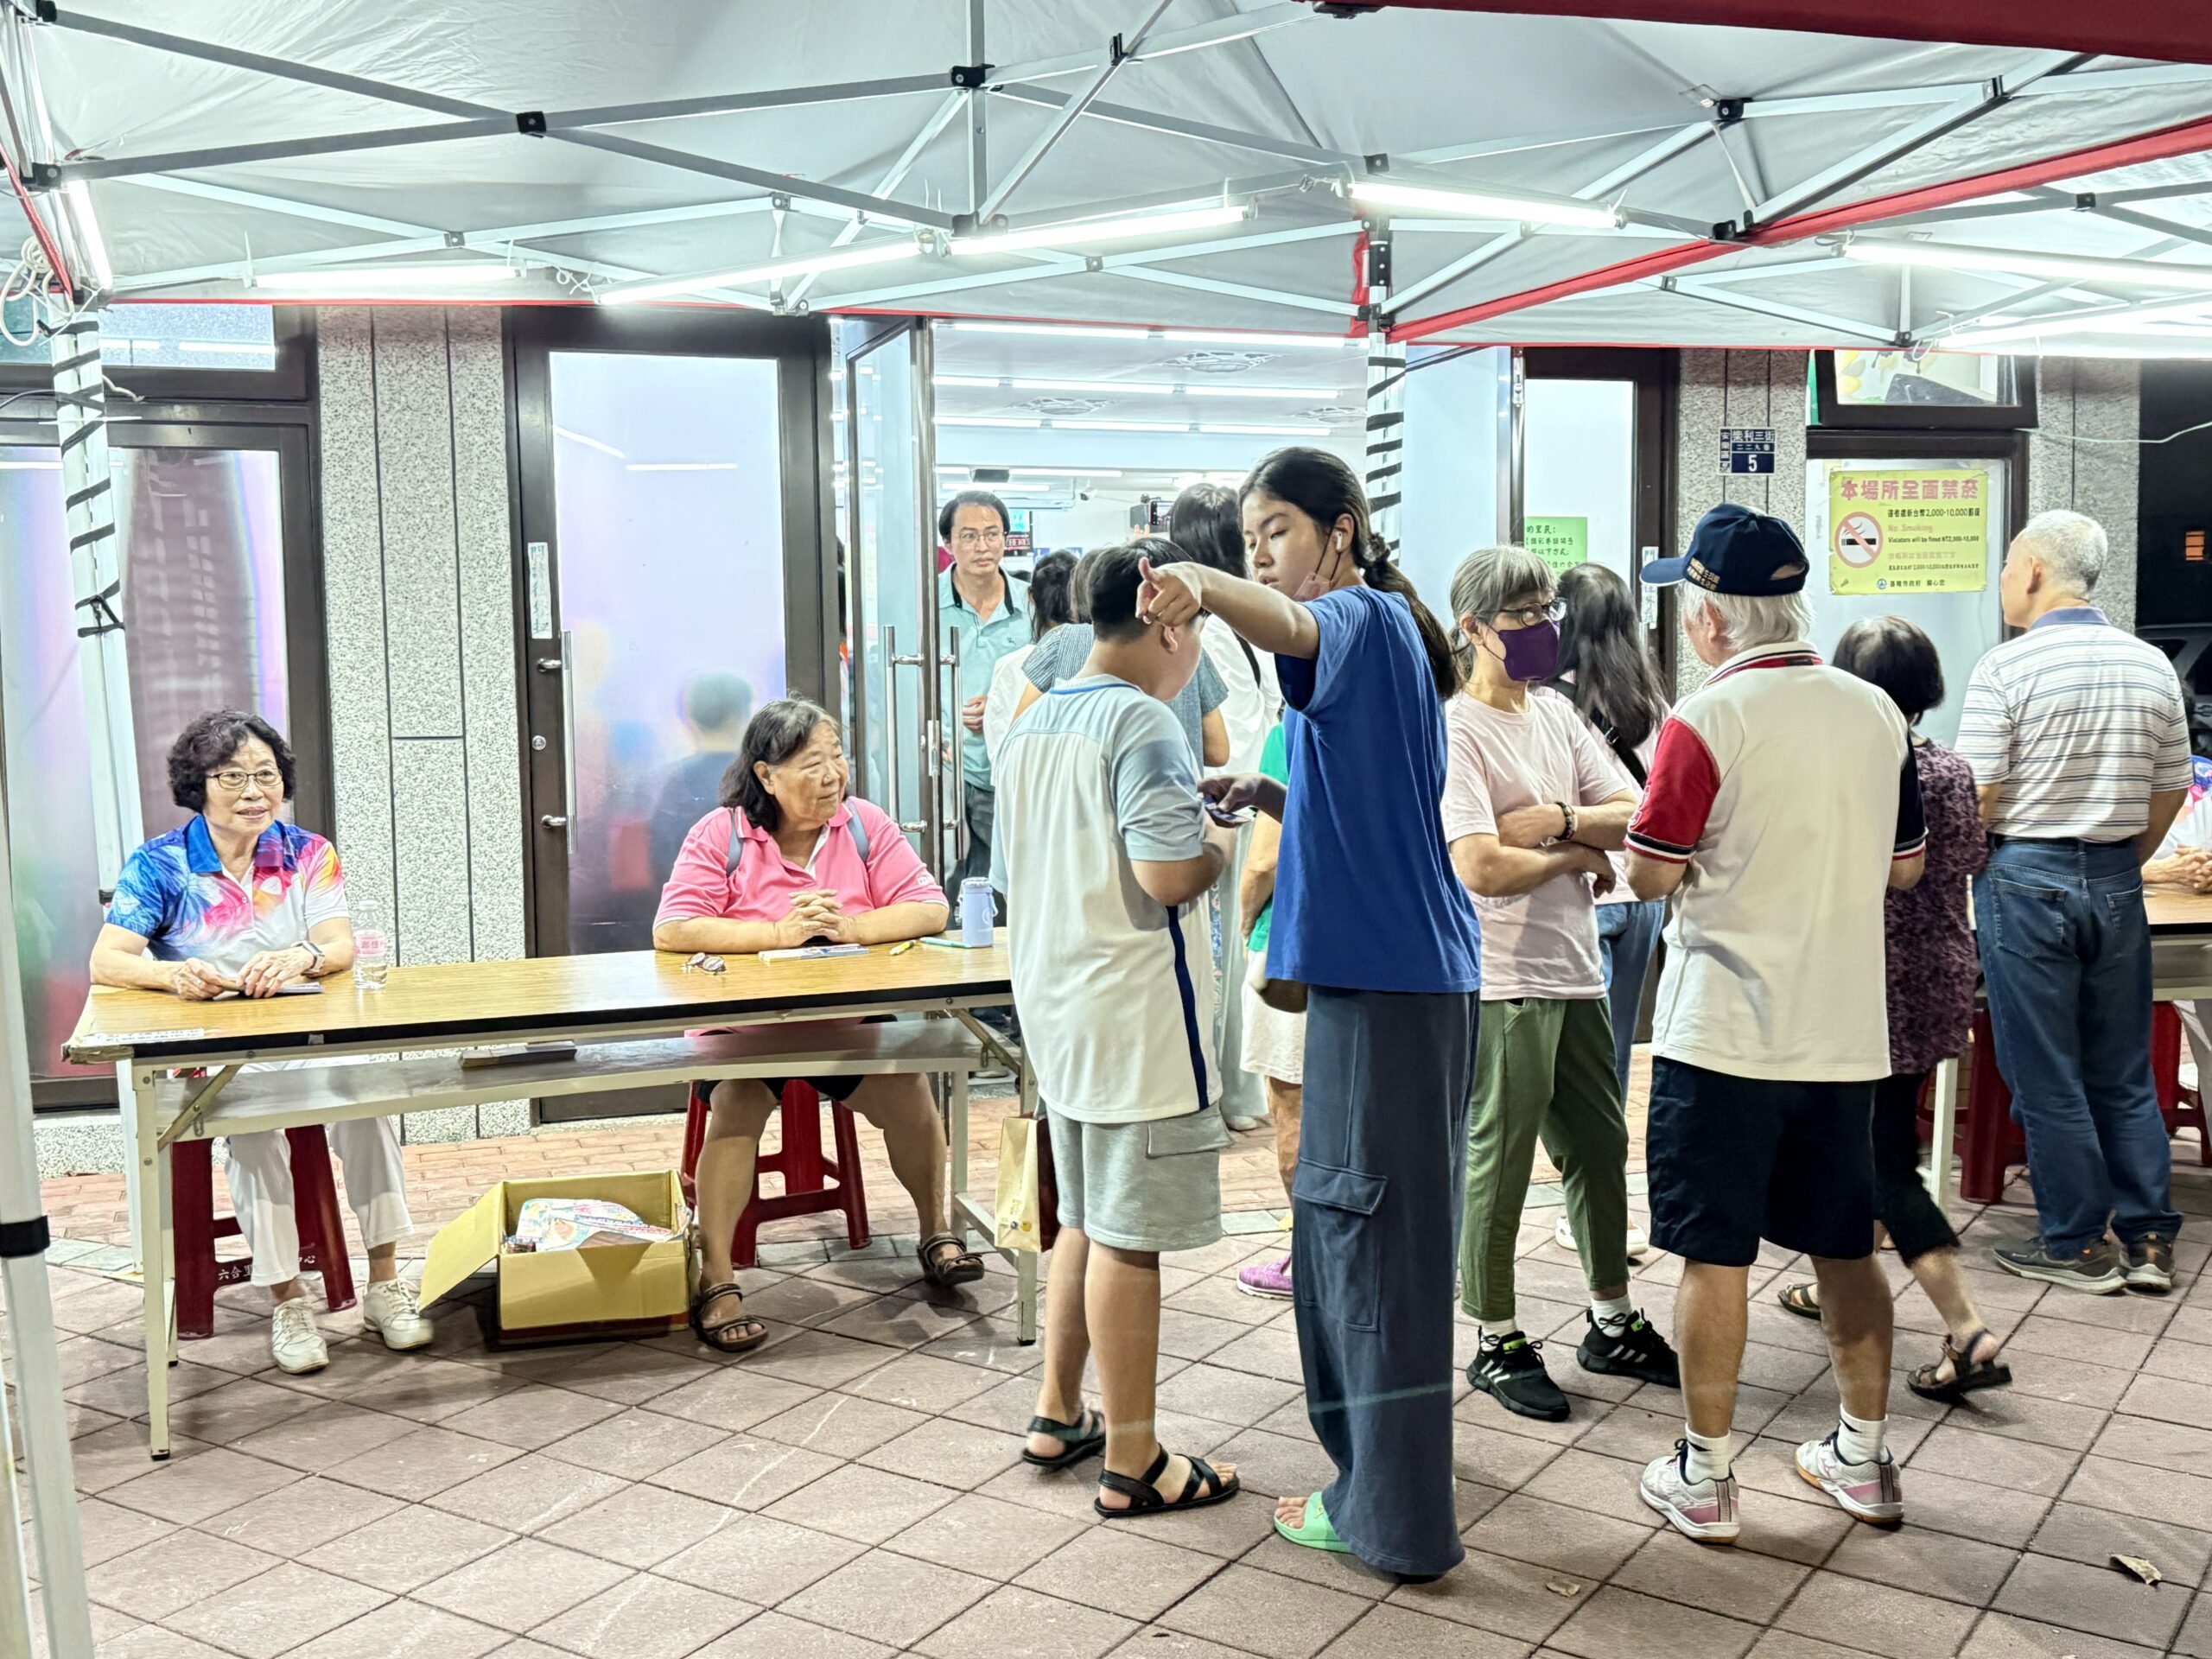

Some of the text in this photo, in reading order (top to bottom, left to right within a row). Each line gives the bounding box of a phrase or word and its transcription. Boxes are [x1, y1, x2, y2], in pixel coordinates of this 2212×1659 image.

[1748, 454, 1758, 472] 5
[1840, 478, 1979, 500] 本場所全面禁菸
[1901, 524, 1933, 533] Smoking
